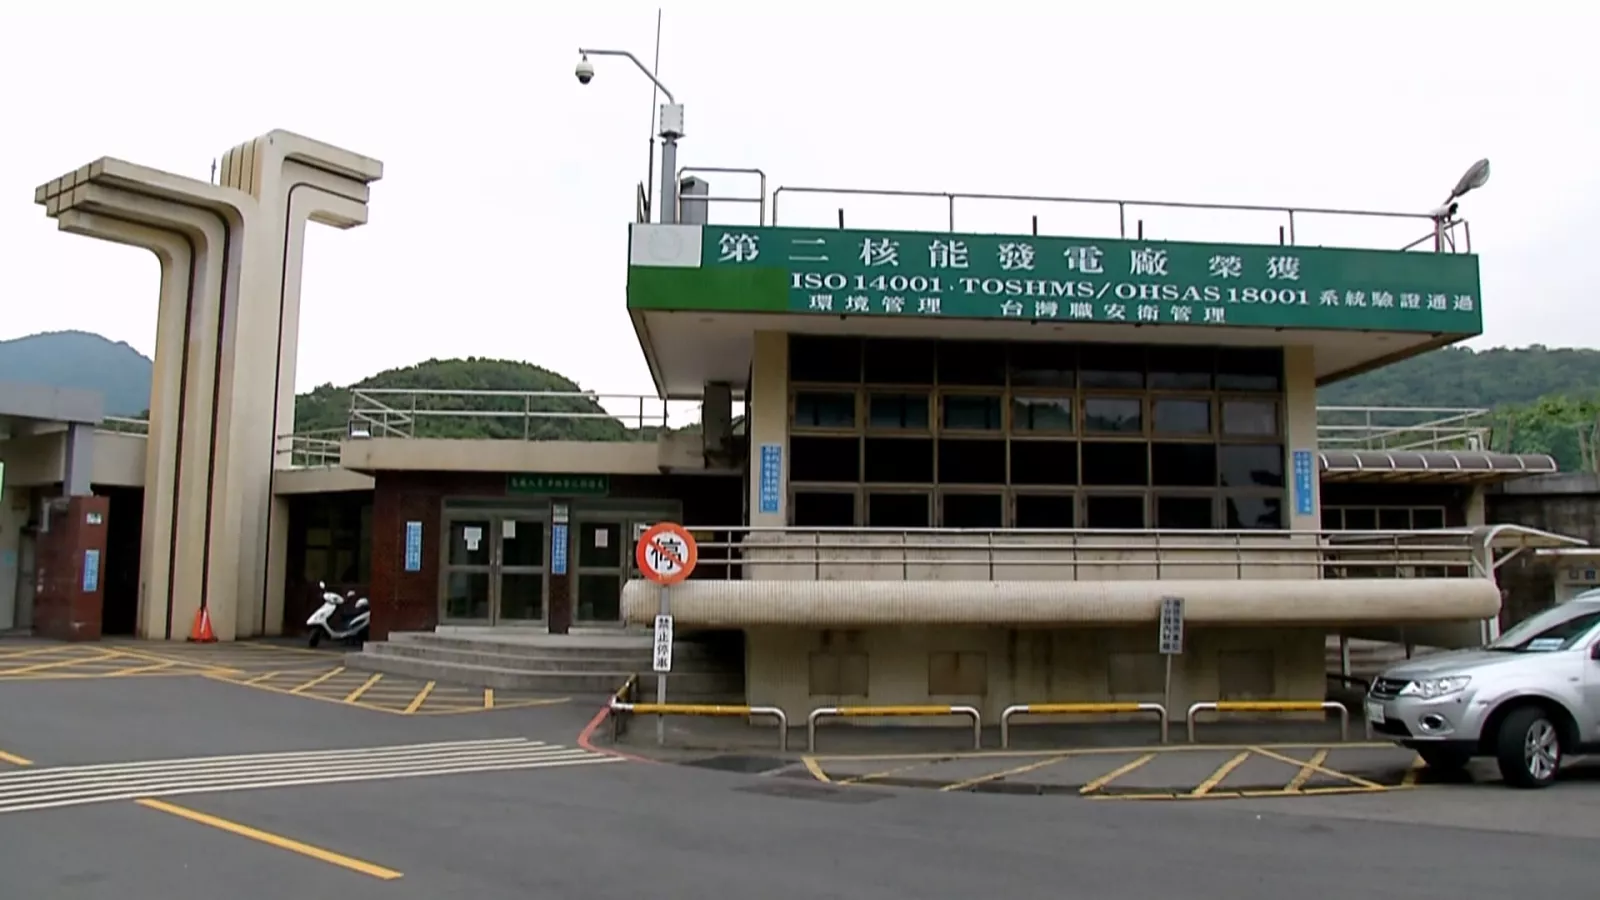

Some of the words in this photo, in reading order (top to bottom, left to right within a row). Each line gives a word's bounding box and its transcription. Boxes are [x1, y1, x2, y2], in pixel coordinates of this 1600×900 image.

[792, 272, 848, 289] ISO
[853, 274, 944, 292] 14001
[1227, 287, 1311, 305] 18001
[1319, 289, 1474, 311] 系統驗證通過
[809, 294, 941, 314] 環境管理
